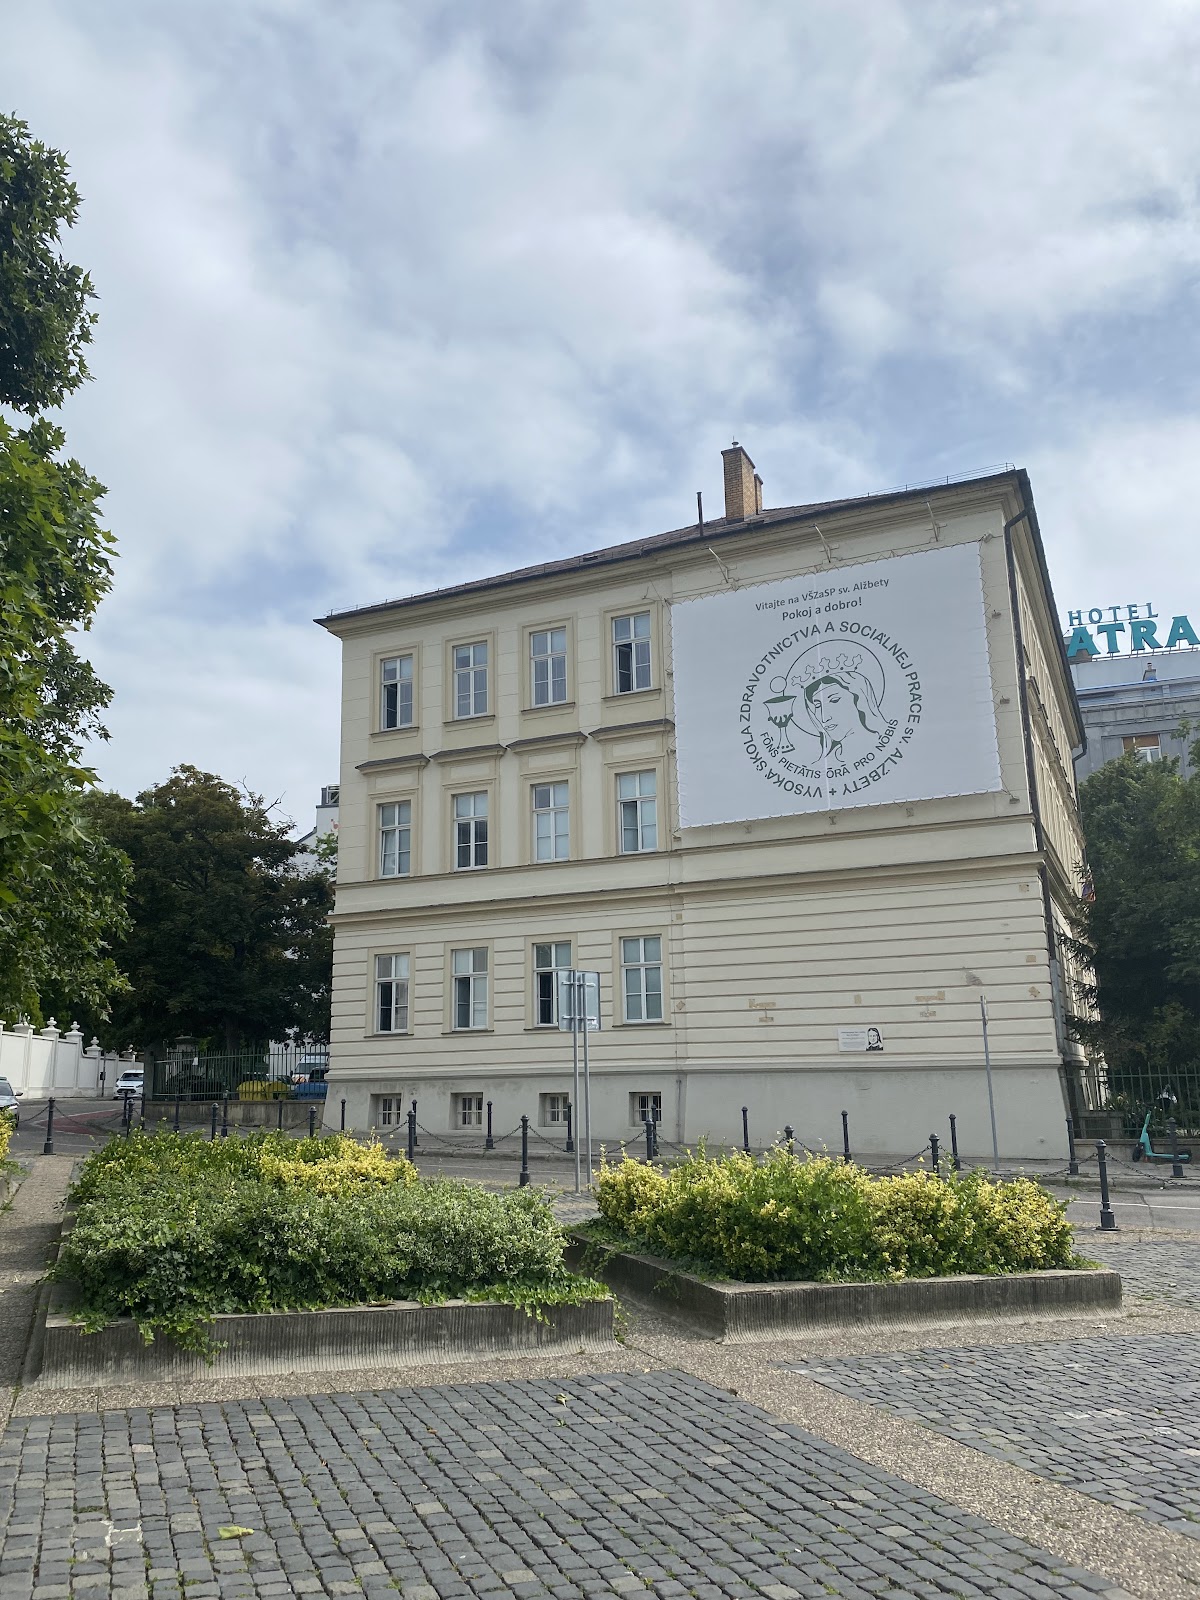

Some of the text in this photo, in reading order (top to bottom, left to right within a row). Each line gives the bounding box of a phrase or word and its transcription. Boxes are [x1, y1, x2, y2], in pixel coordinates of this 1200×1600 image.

[755, 578, 889, 611] Vitajte na VŠZaSP sv. Alžbety
[782, 596, 862, 621] Pokoj a dobro!
[1067, 602, 1158, 626] HOTEL
[739, 621, 922, 798] VYSOKÁ ŠKOLA ZDRAVOTNÍCTVA A SOCIÁLNEJ PRÁCE SV. ALŽBETY
[853, 752, 875, 770] PRO
